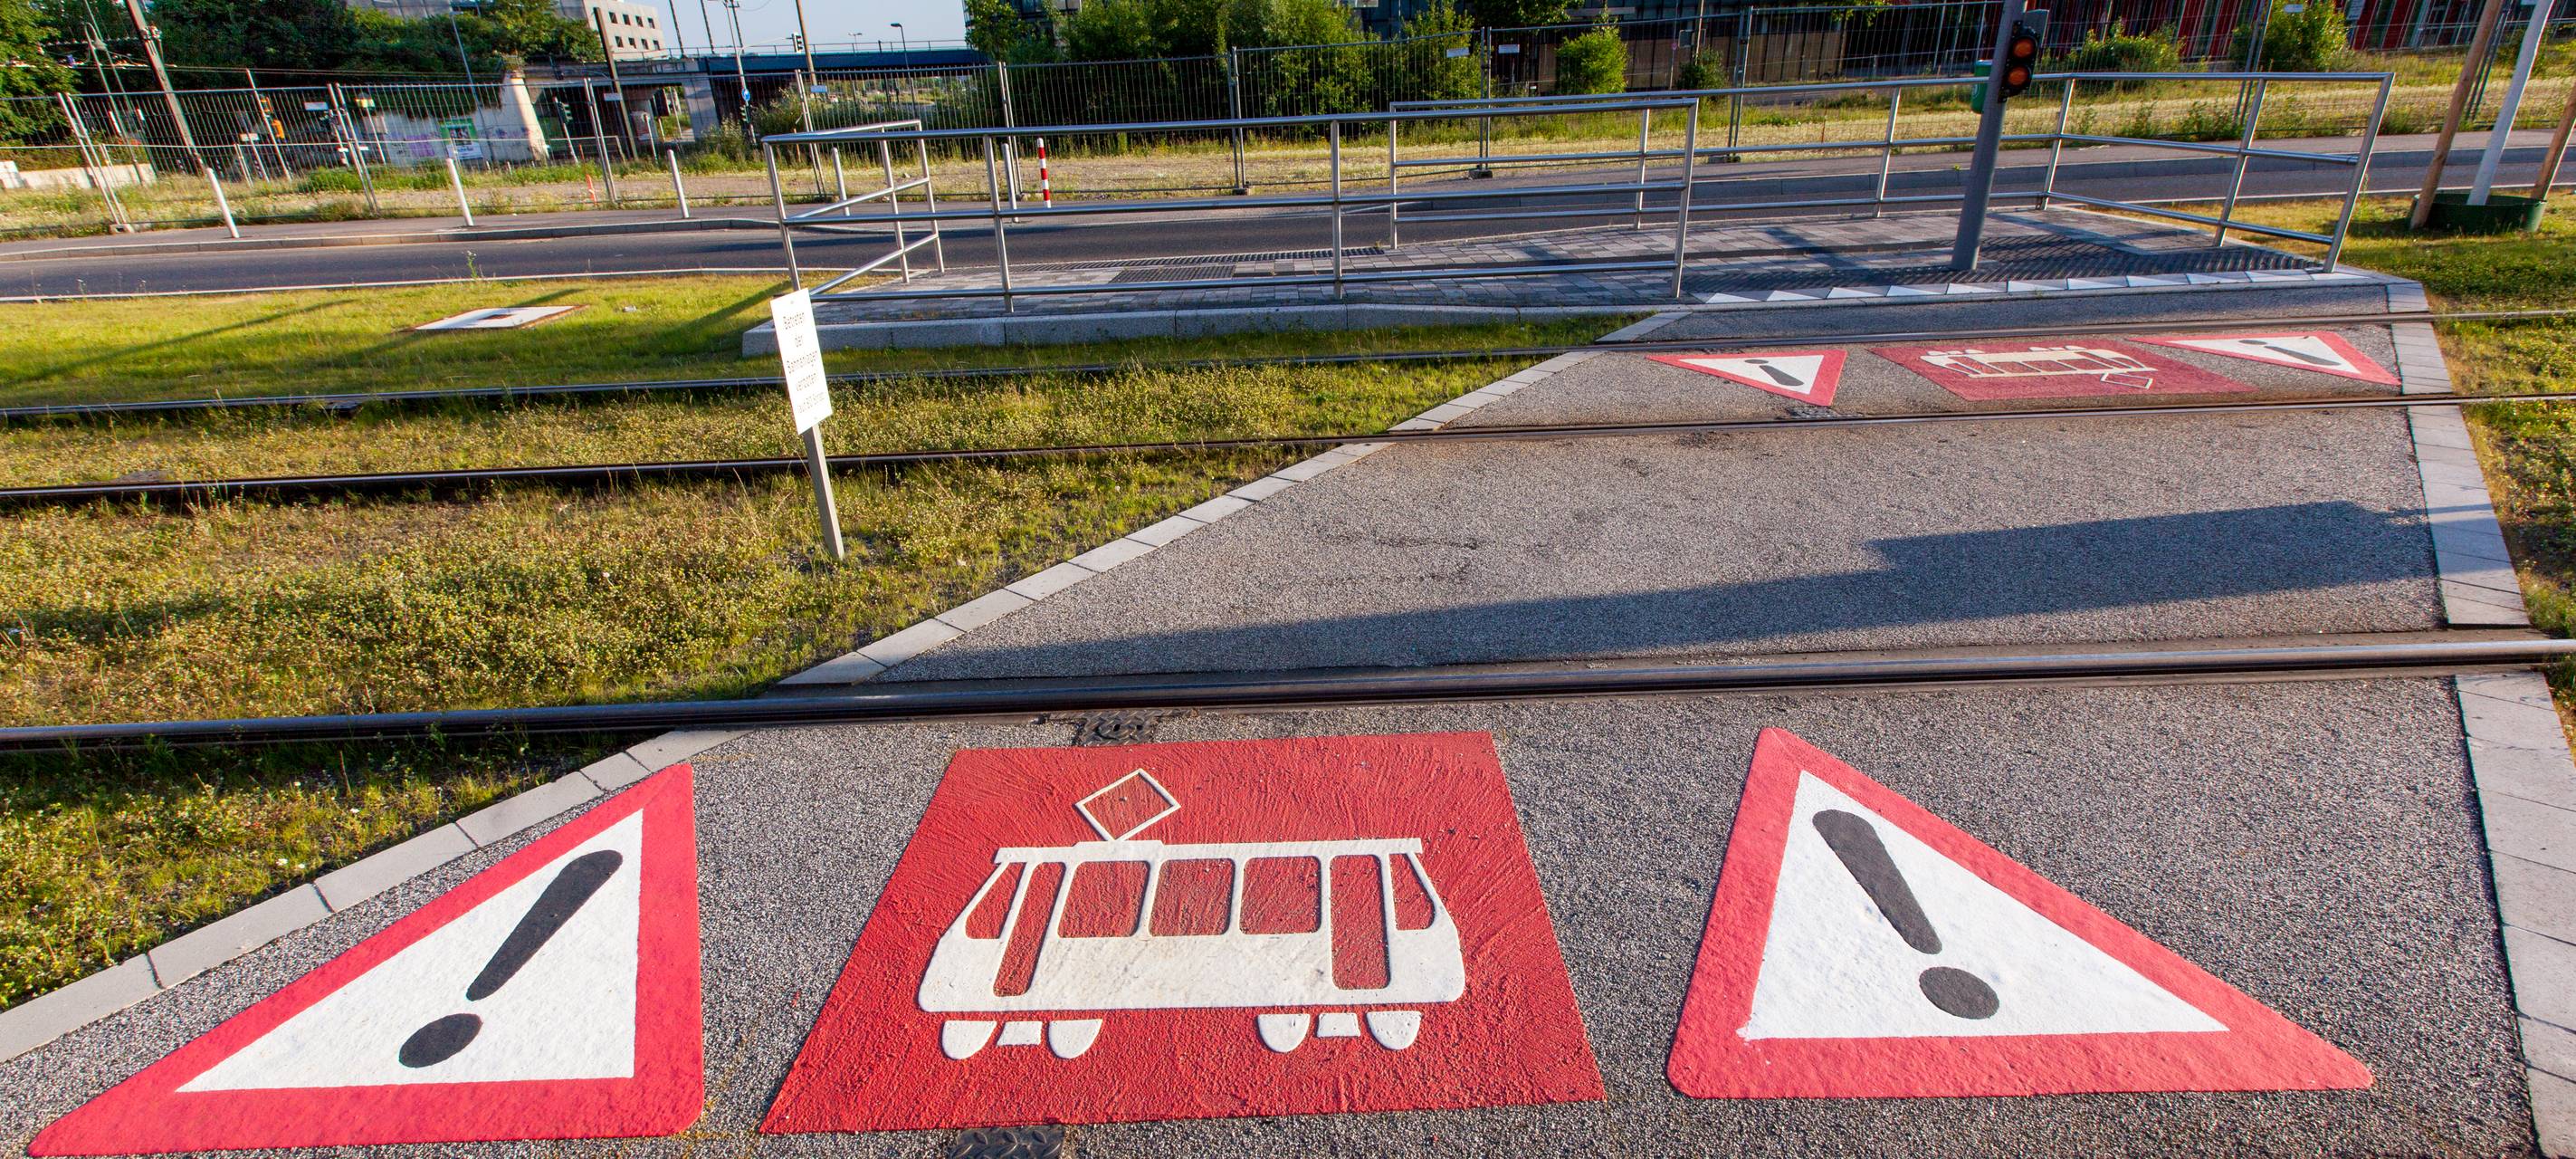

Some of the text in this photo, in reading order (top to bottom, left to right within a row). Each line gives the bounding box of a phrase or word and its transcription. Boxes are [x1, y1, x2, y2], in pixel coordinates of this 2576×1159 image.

[783, 311, 805, 330] Betreten
[794, 333, 804, 348] der
[796, 372, 817, 392] verboten
